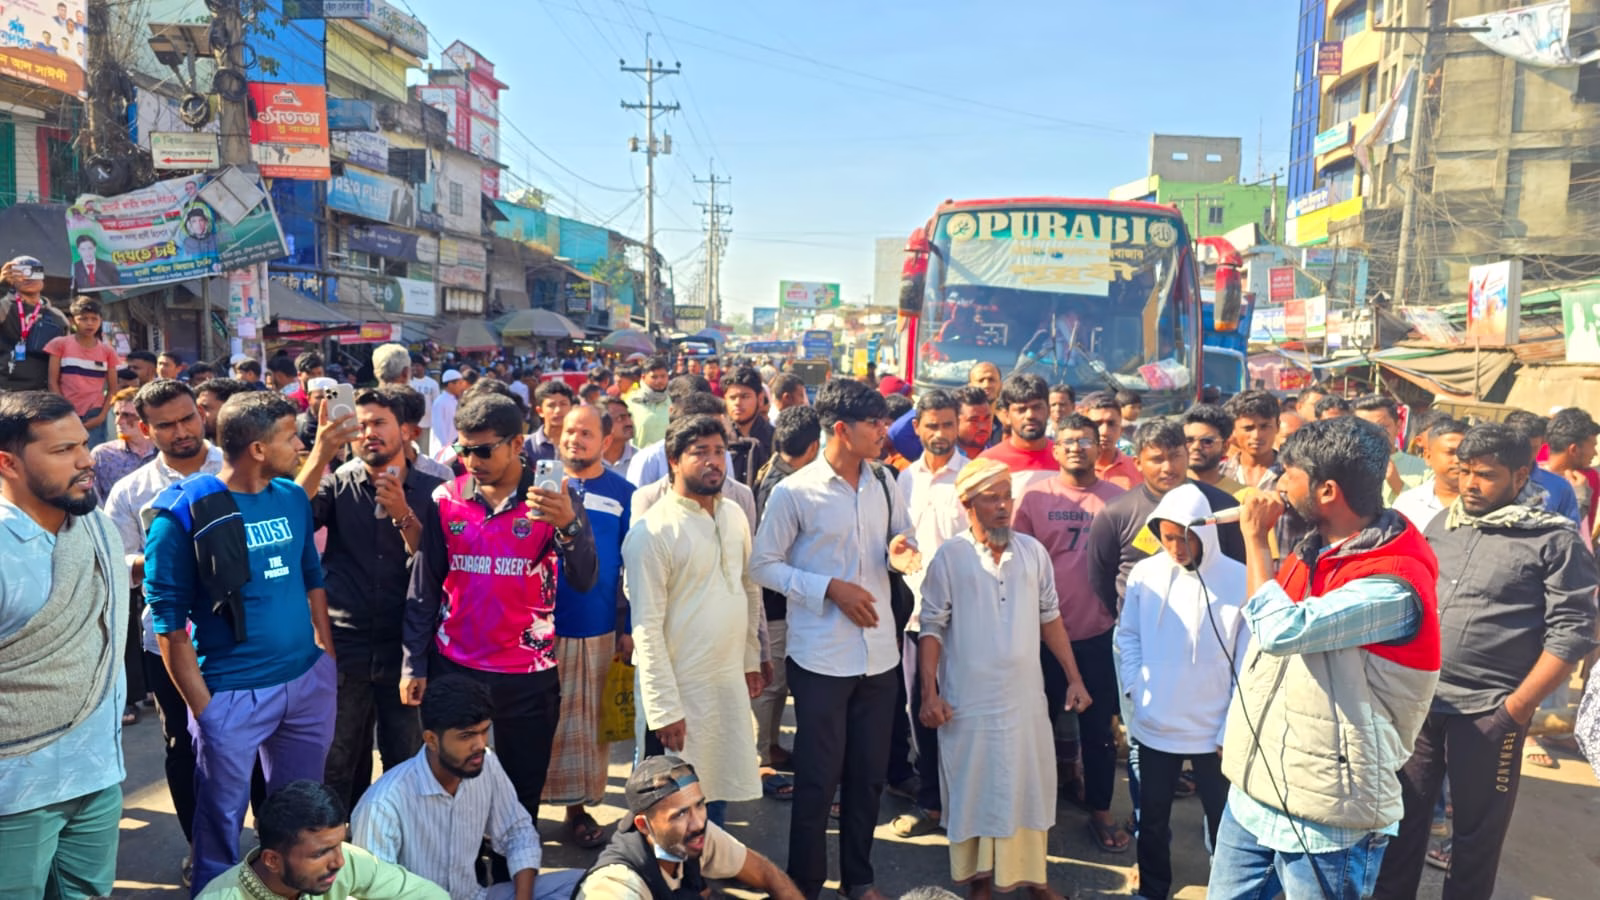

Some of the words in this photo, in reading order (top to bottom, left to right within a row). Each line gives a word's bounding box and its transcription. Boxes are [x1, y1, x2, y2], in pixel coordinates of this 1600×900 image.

[257, 106, 320, 126] সততা
[978, 212, 1147, 244] PURABI
[112, 249, 151, 264] দেখতে
[155, 240, 177, 258] চাই
[244, 517, 293, 549] TRUST
[268, 556, 283, 569] THE
[494, 558, 533, 576] SIXER'S
[1496, 732, 1517, 792] FERNANDO
